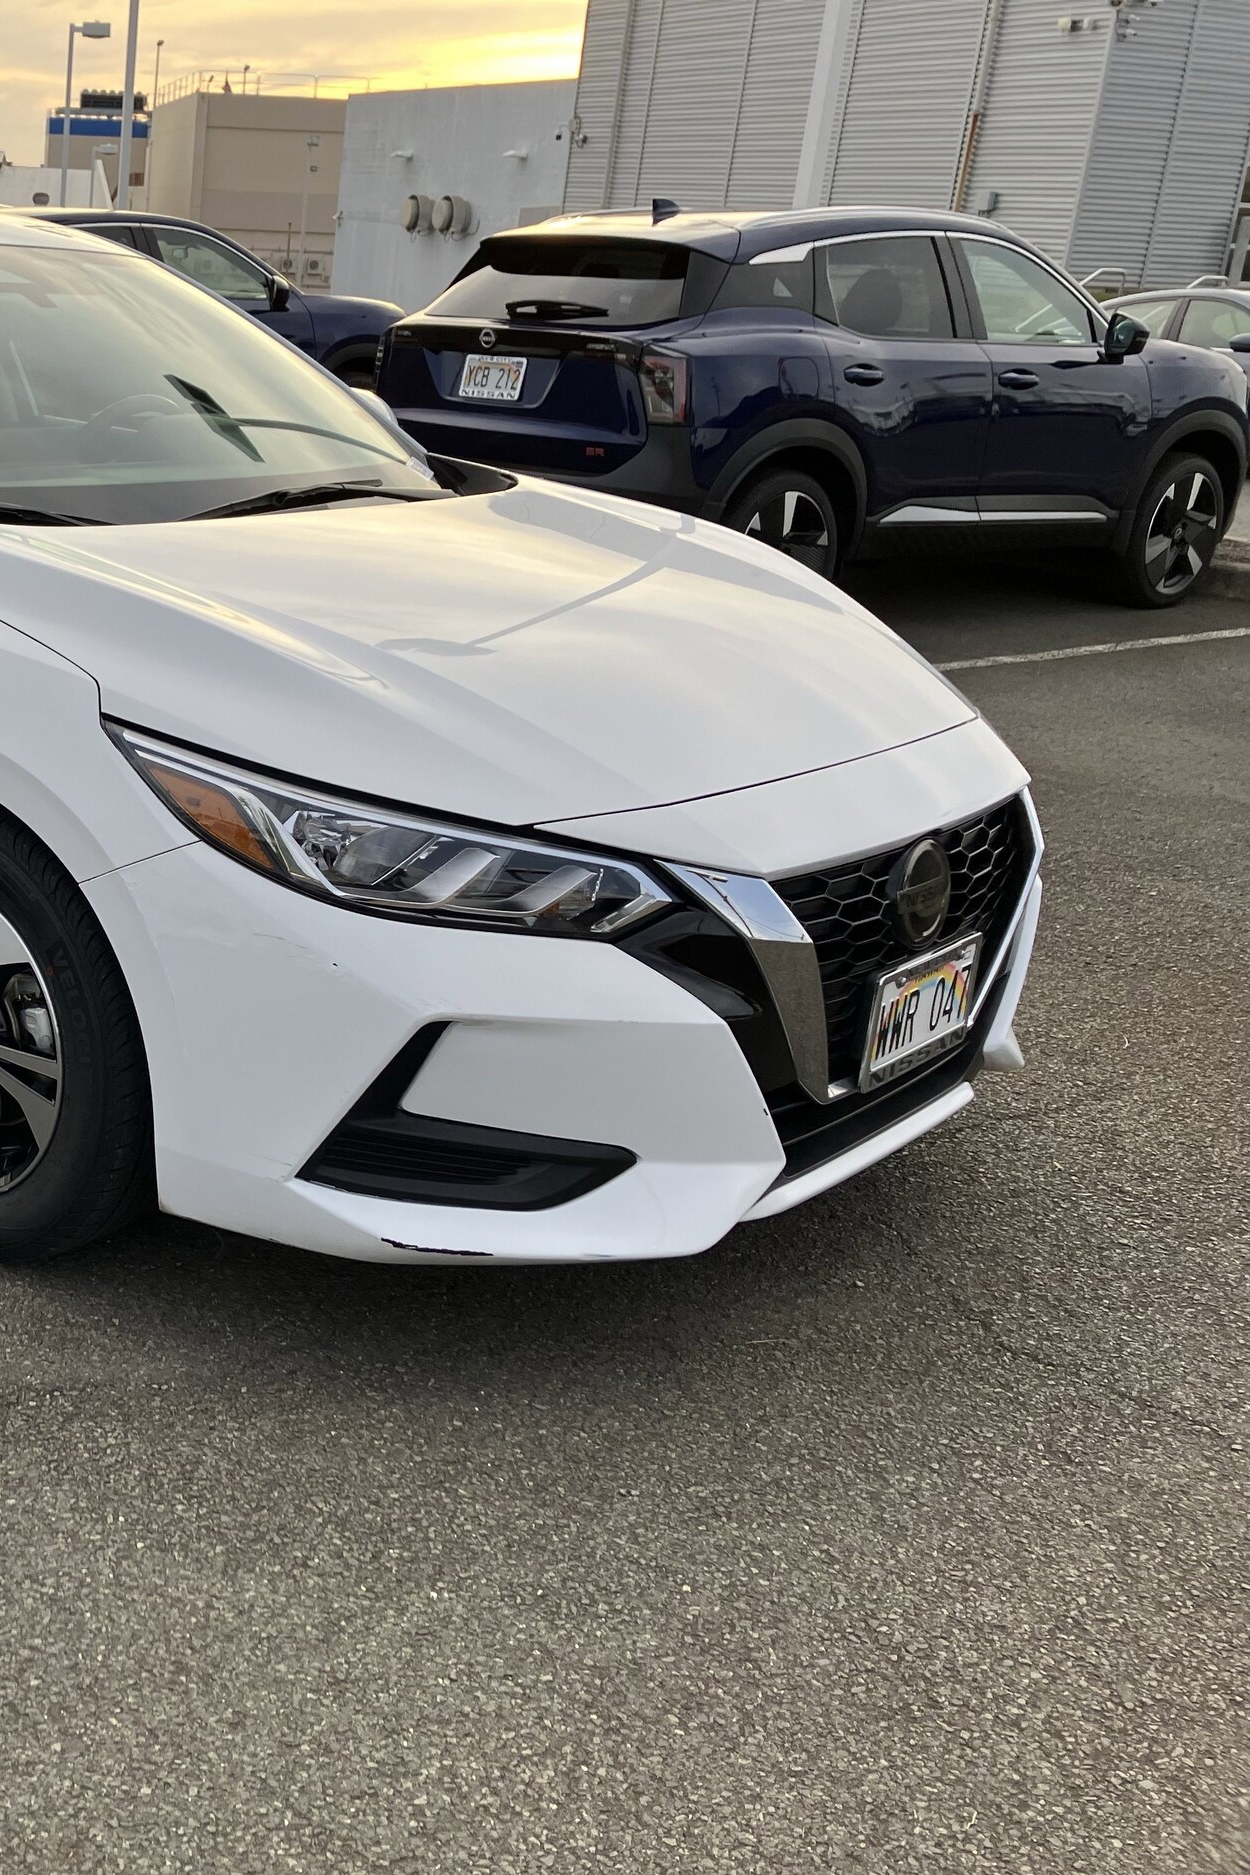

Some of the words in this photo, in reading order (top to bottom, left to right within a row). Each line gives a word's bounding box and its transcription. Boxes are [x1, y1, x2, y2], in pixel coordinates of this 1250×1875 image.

[467, 364, 491, 389] YCB
[496, 367, 522, 391] 212
[461, 389, 517, 400] NISSAN
[586, 447, 604, 457] SR
[874, 988, 921, 1062] WWR
[929, 963, 973, 1031] 047
[867, 1026, 965, 1088] NISSAN
